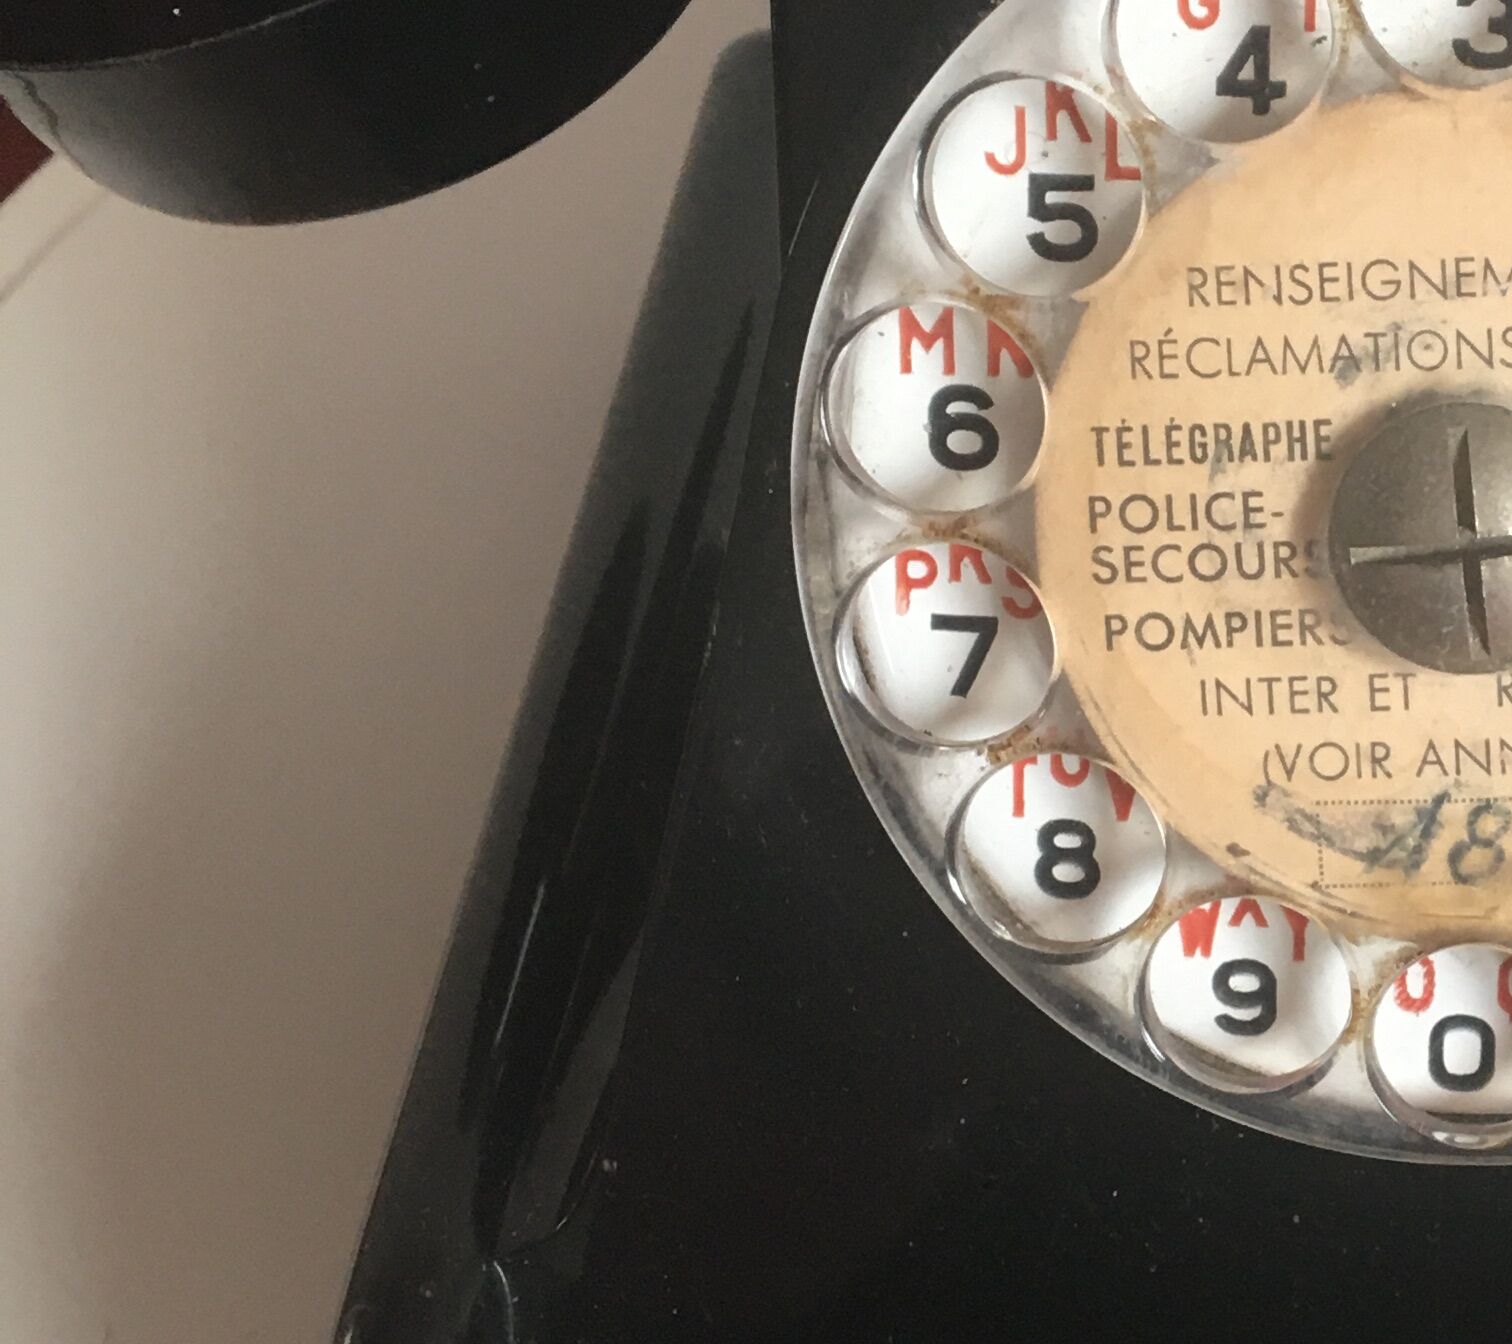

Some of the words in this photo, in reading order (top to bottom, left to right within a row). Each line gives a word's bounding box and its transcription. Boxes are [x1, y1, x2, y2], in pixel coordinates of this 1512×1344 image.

[1215, 24, 1287, 116] 4
[1026, 174, 1099, 262] 5
[927, 383, 999, 471] 6
[1090, 417, 1333, 467] TÉLÉGRAPHE
[1088, 491, 1284, 534] POLICE-
[931, 613, 998, 699] 7
[1200, 674, 1338, 718] INTER
[1368, 673, 1417, 712] ET
[1263, 740, 1394, 787] (VOIR
[1034, 818, 1100, 900] 8
[1212, 958, 1277, 1036] 9
